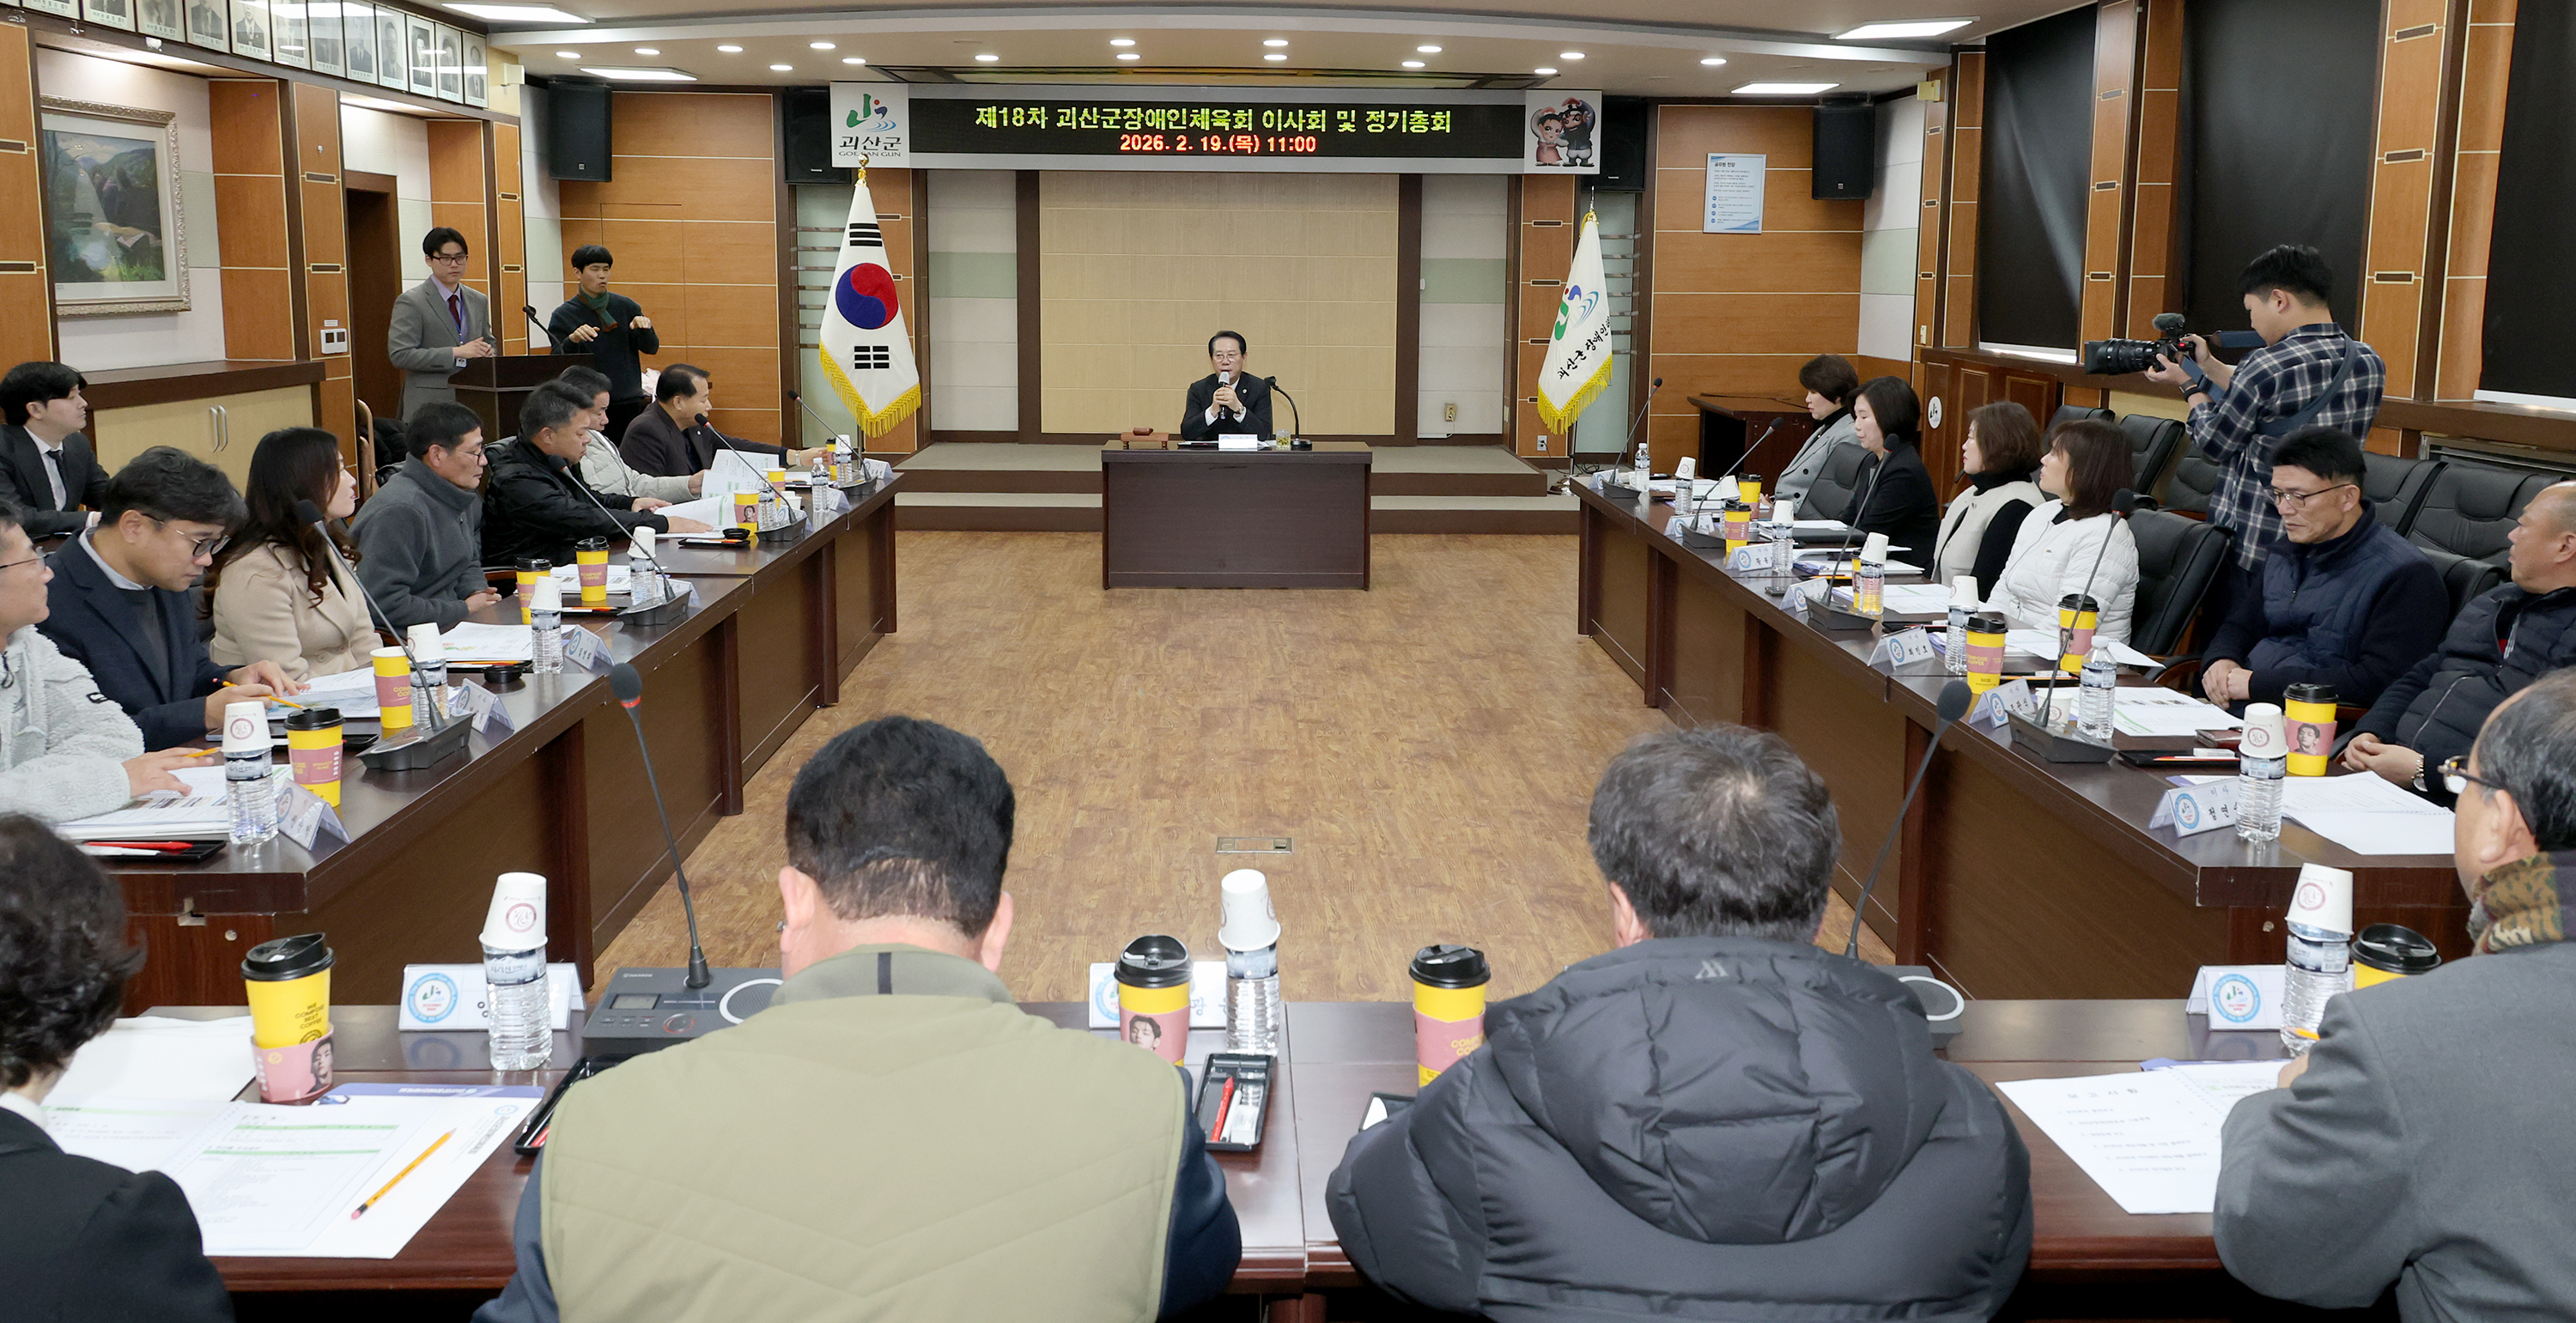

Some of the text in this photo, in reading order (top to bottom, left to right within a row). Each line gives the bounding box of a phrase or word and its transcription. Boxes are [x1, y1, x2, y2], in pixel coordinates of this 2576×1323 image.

[975, 106, 1451, 134] 제18차 괴산군장애인체육회 이사회 및 정기총회
[839, 136, 902, 151] 괴산군
[1119, 134, 1317, 154] 2026. 2. 19.(목) 11:00
[1557, 349, 1587, 379] 괴산군
[2210, 784, 2230, 797] 이사
